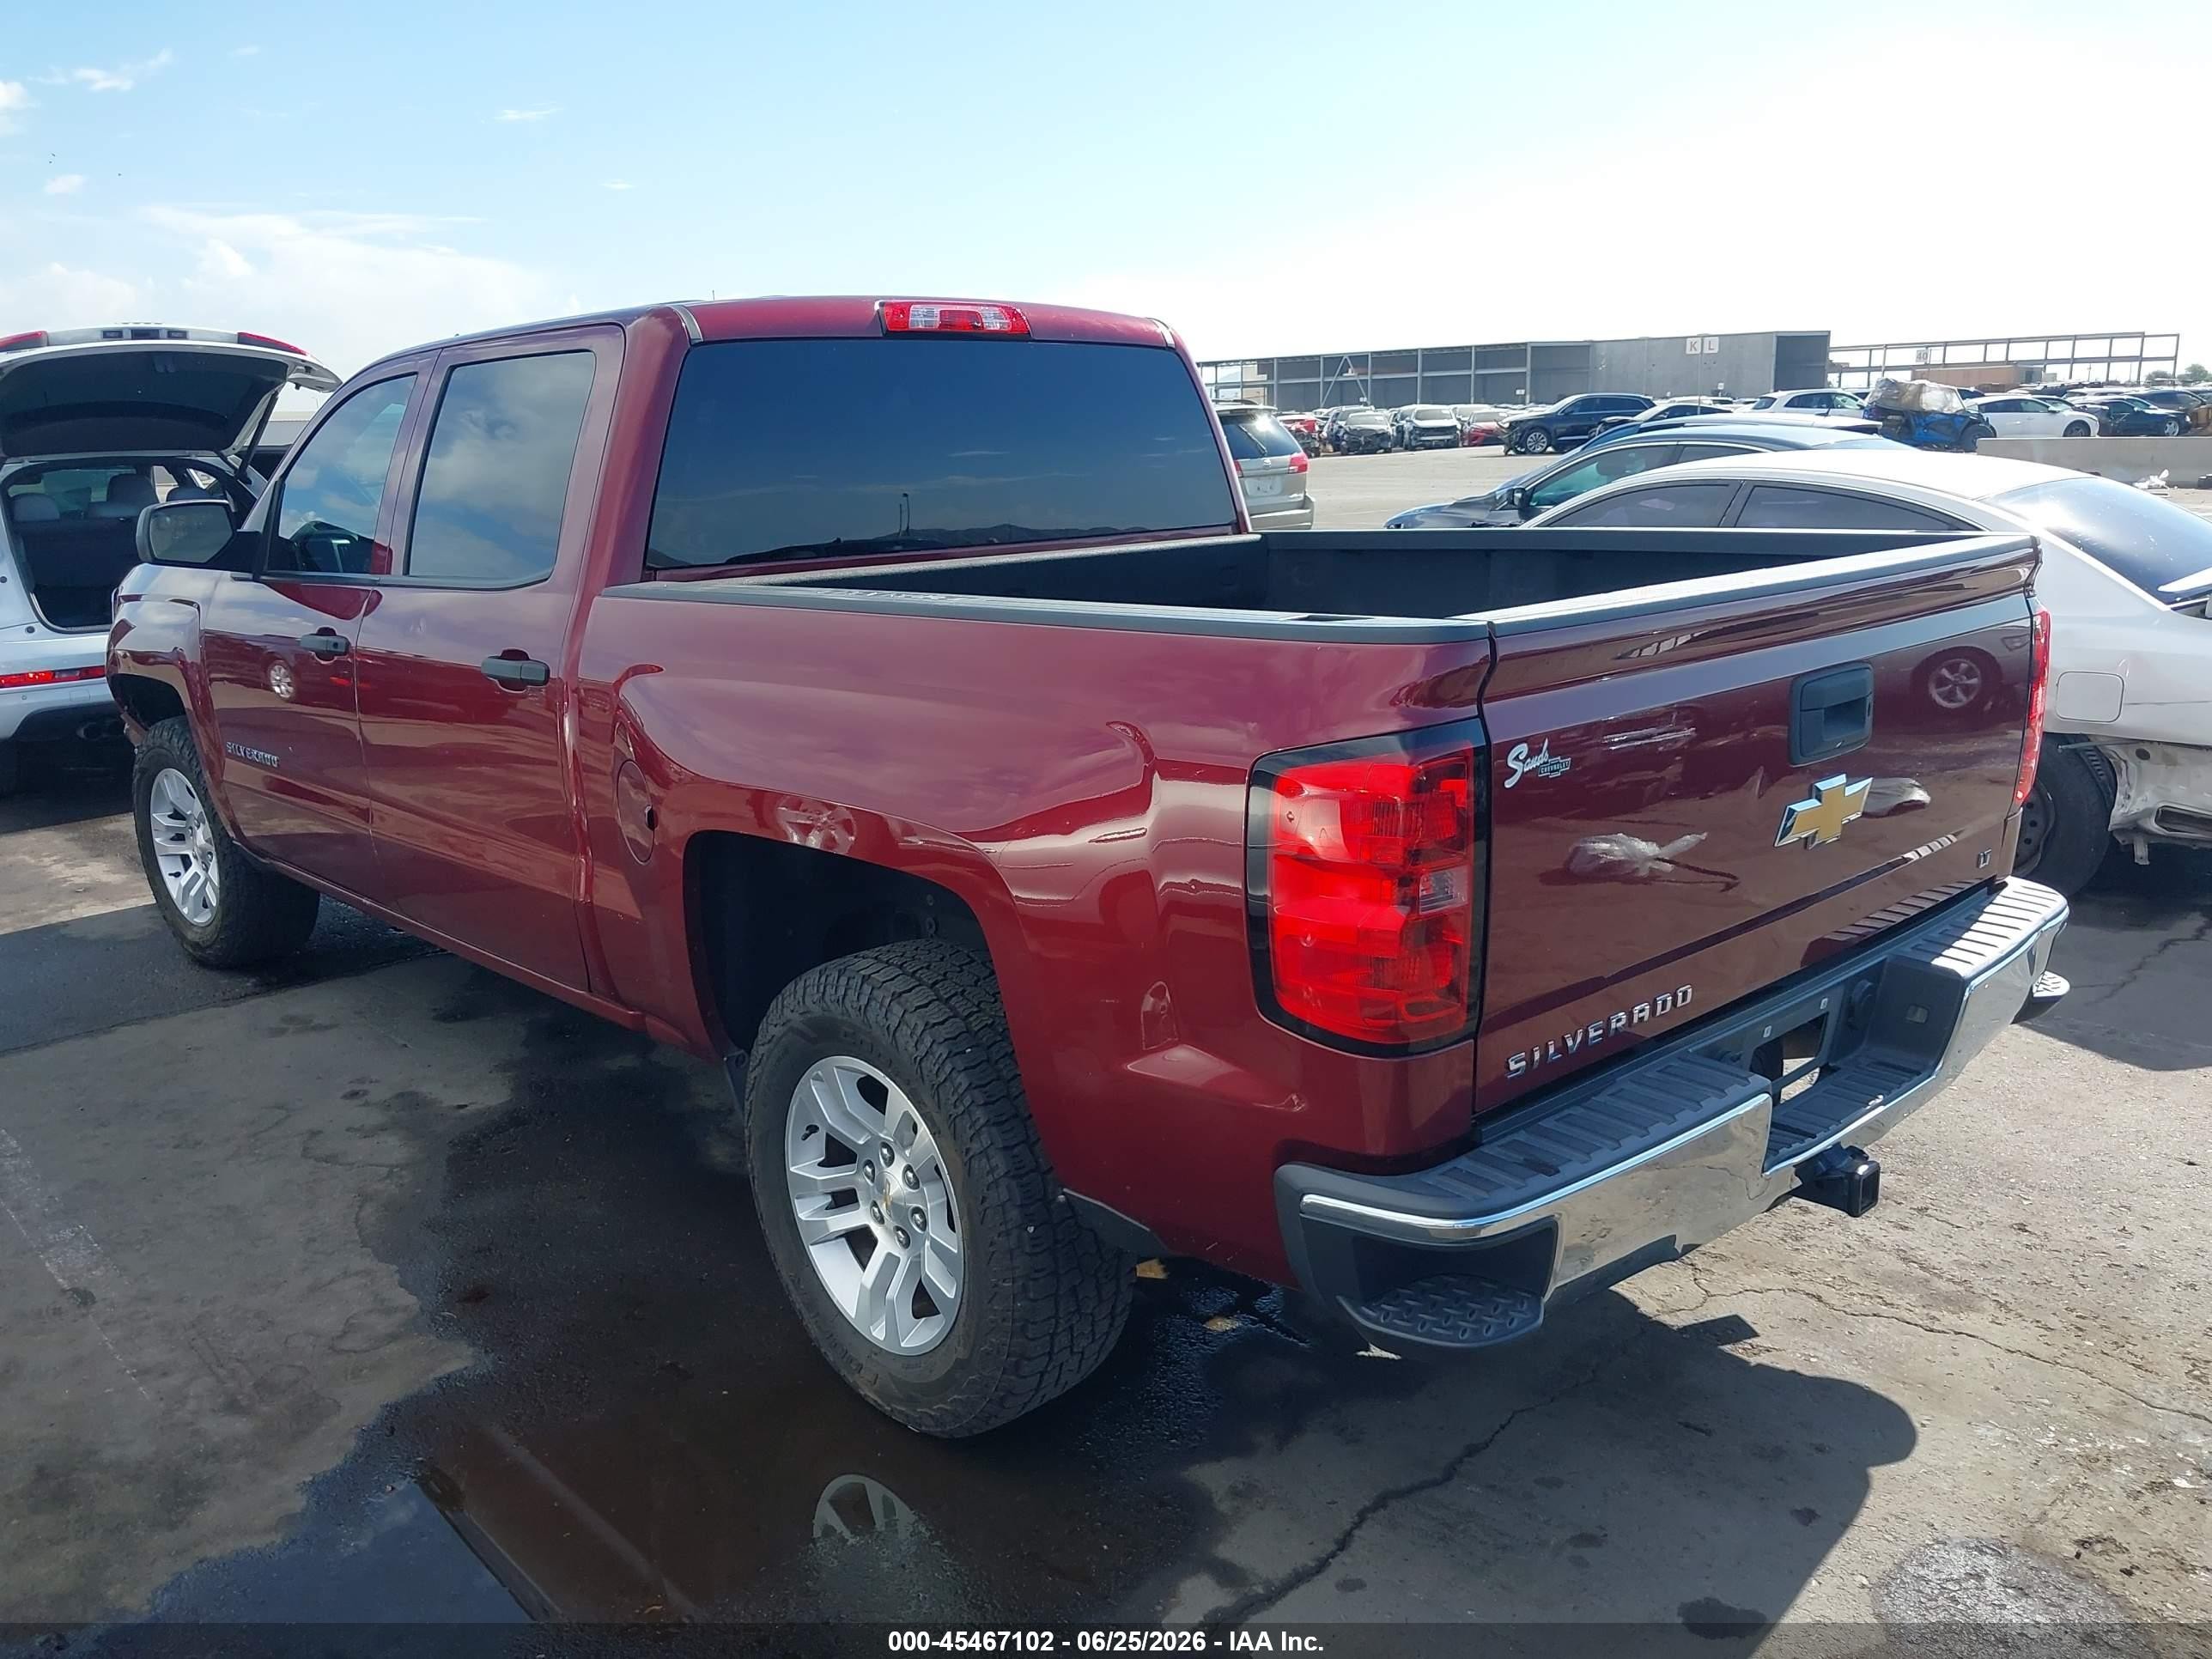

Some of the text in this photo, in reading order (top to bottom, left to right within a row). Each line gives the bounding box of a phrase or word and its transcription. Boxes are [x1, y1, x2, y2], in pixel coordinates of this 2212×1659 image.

[1689, 340, 1716, 352] K L
[1916, 350, 1929, 361] 40
[1540, 761, 1570, 775] CHEVROLET
[1506, 984, 1694, 1079] SILVERADO
